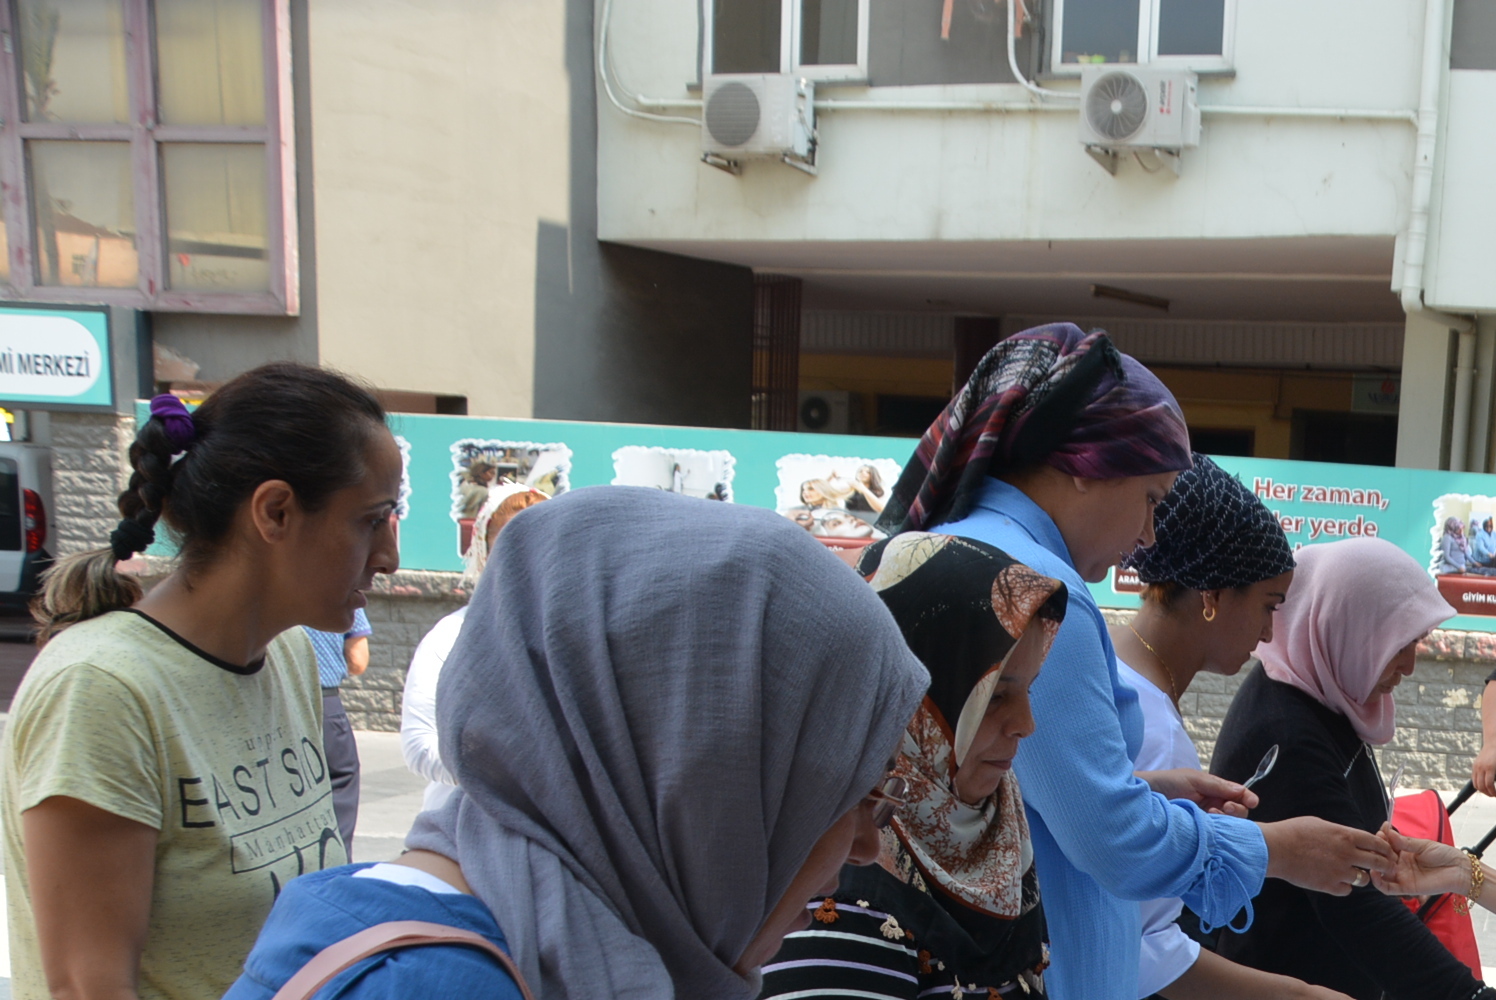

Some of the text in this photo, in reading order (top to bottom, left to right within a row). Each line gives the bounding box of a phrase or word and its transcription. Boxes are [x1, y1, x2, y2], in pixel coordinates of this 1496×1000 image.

[17, 350, 90, 377] MERKEZİ
[1254, 477, 1389, 510] Her zaman,
[1274, 511, 1378, 539] er yerde
[179, 736, 325, 828] EAST SID
